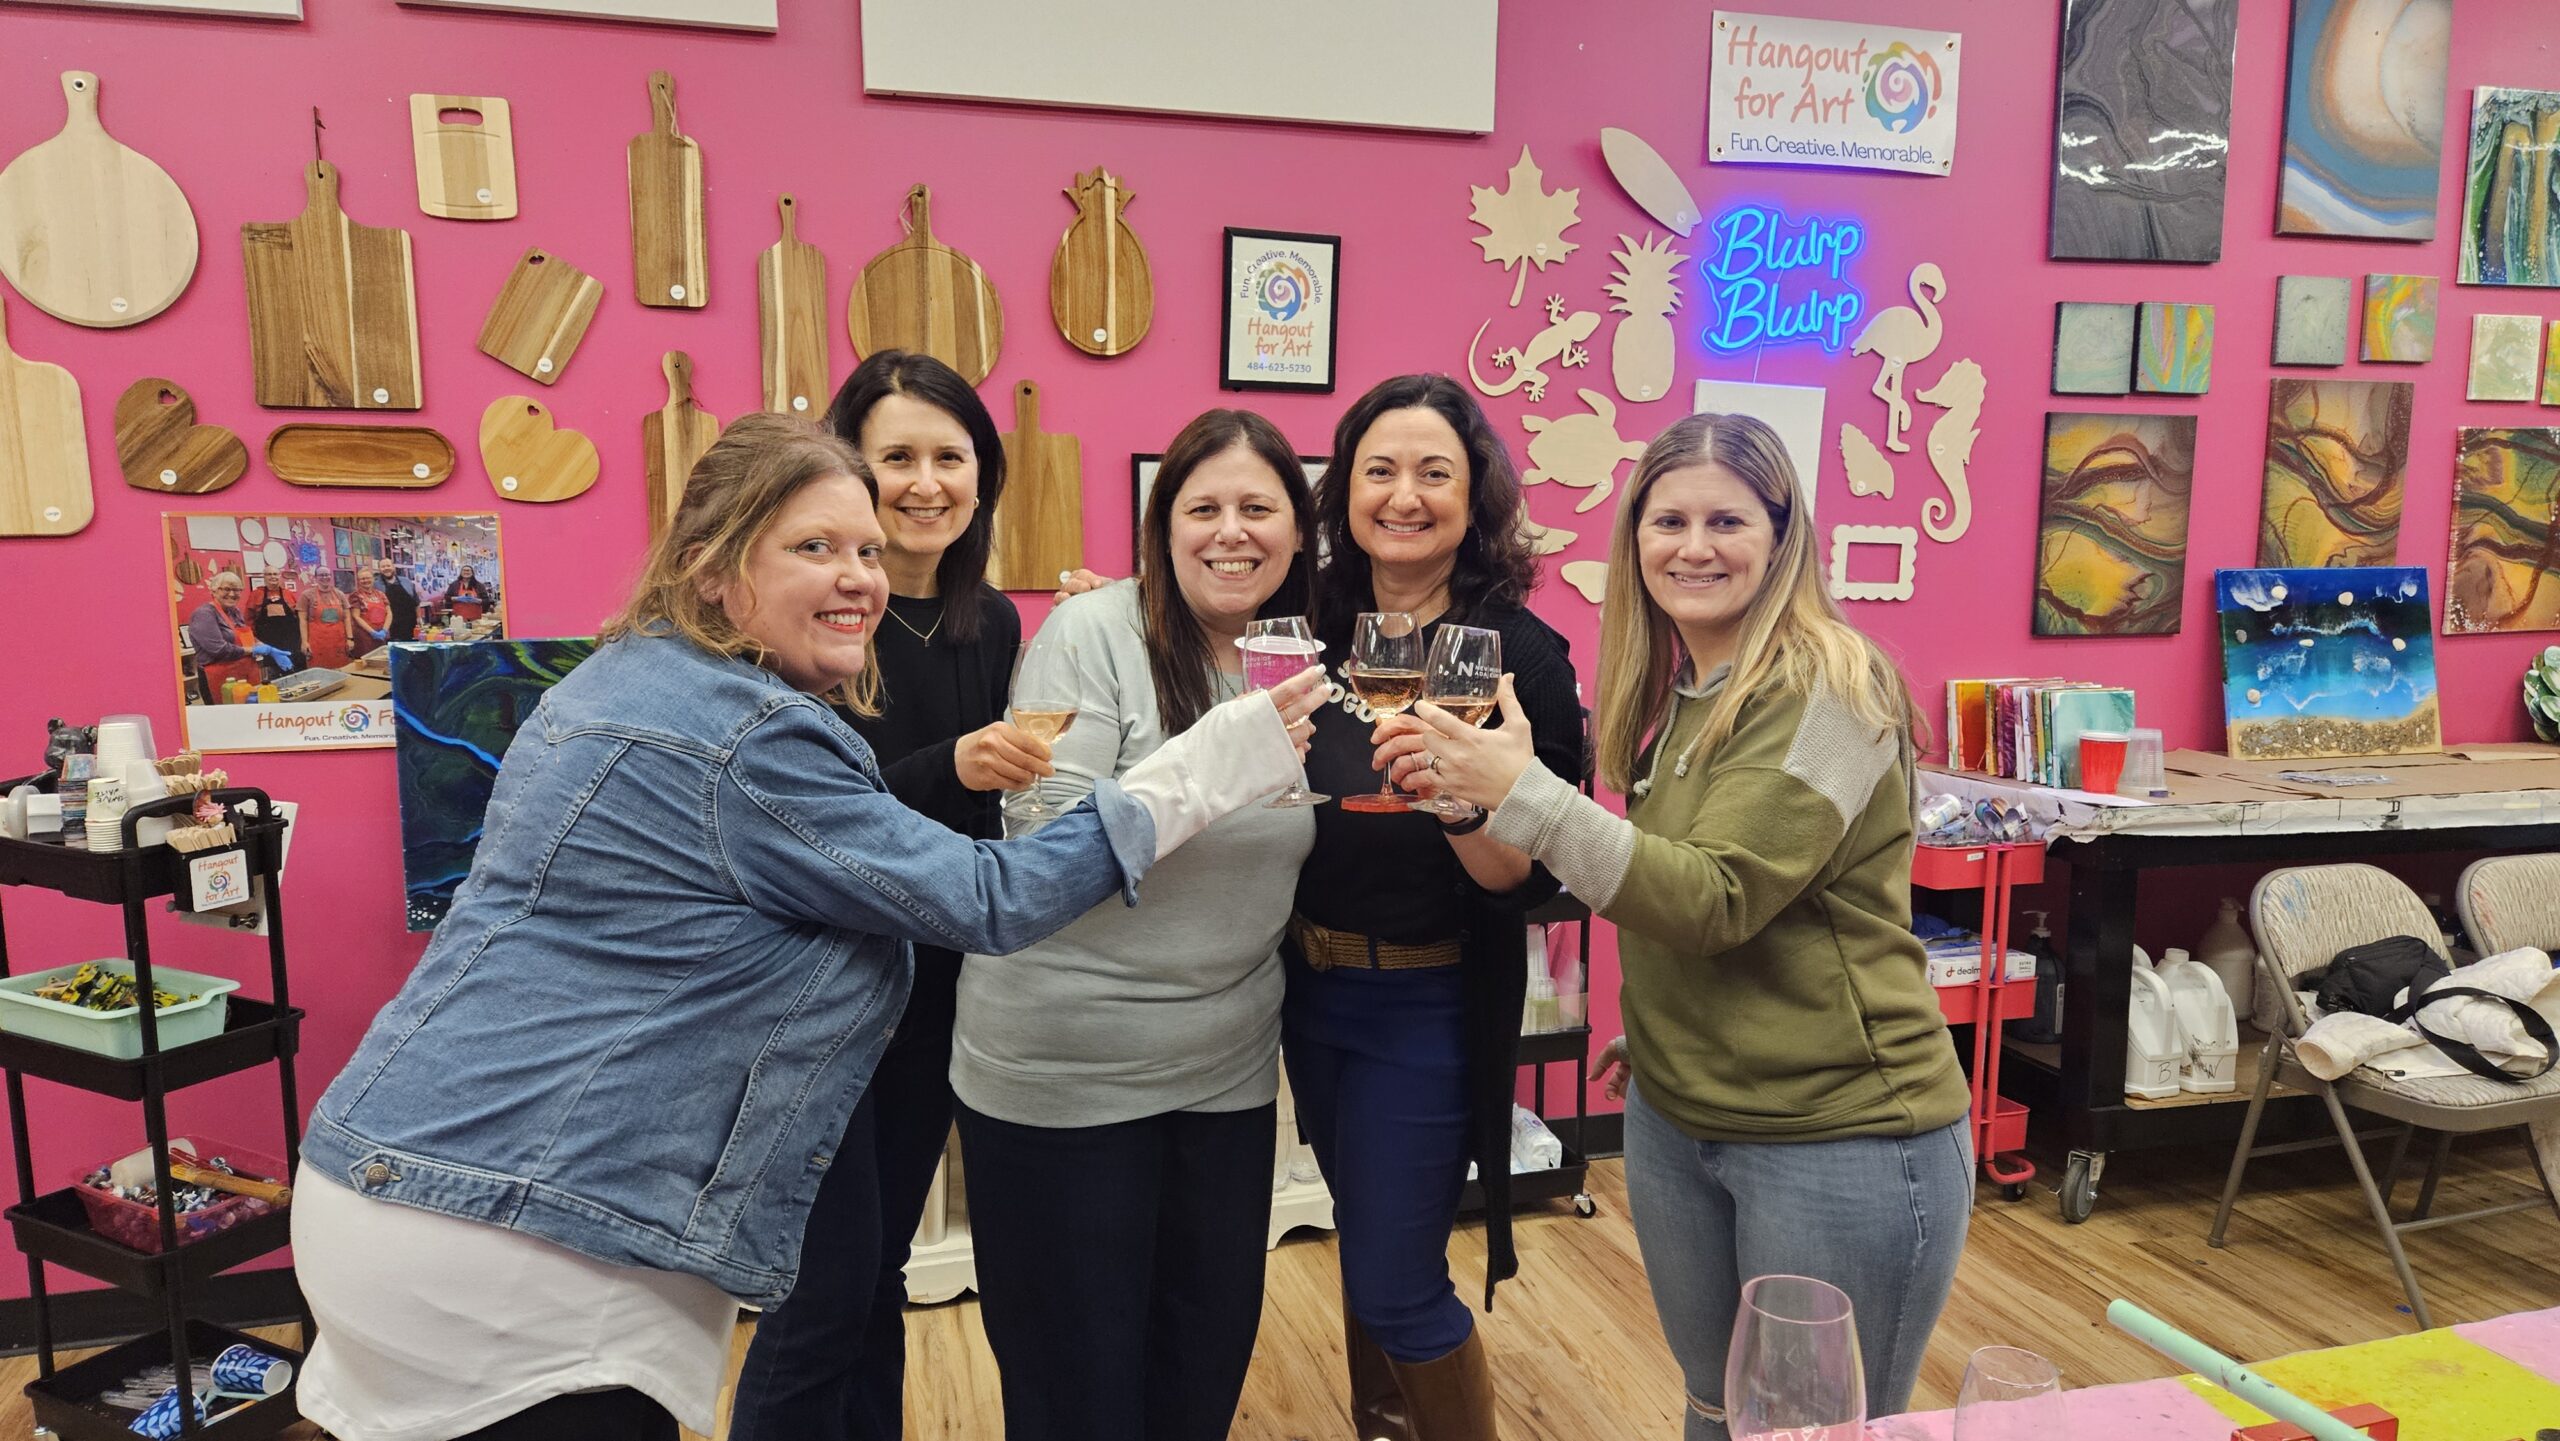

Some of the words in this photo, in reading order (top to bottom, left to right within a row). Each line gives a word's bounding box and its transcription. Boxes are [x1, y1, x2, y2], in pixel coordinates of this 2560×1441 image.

[1728, 25, 1868, 88] Hangout
[1734, 76, 1784, 119] for
[1791, 83, 1855, 124] Art
[1731, 132, 1762, 152] Fun.
[1765, 135, 1839, 157] Creative.
[1842, 141, 1935, 165] Memorable.
[1708, 208, 1860, 280] Blurp
[1240, 277, 1252, 299] Fun.
[1247, 249, 1287, 275] Creative.
[1289, 250, 1324, 305] Memorable.
[1709, 277, 1859, 349] Blurp
[1248, 317, 1314, 344] Hangout
[1255, 337, 1279, 356] for
[1282, 340, 1312, 357] Art
[1247, 362, 1312, 374] 484-623-5230
[257, 710, 335, 735] Hangout
[198, 855, 238, 872] Hangout
[205, 891, 219, 903] for
[222, 885, 240, 899] Art
[2158, 1061, 2172, 1085] B
